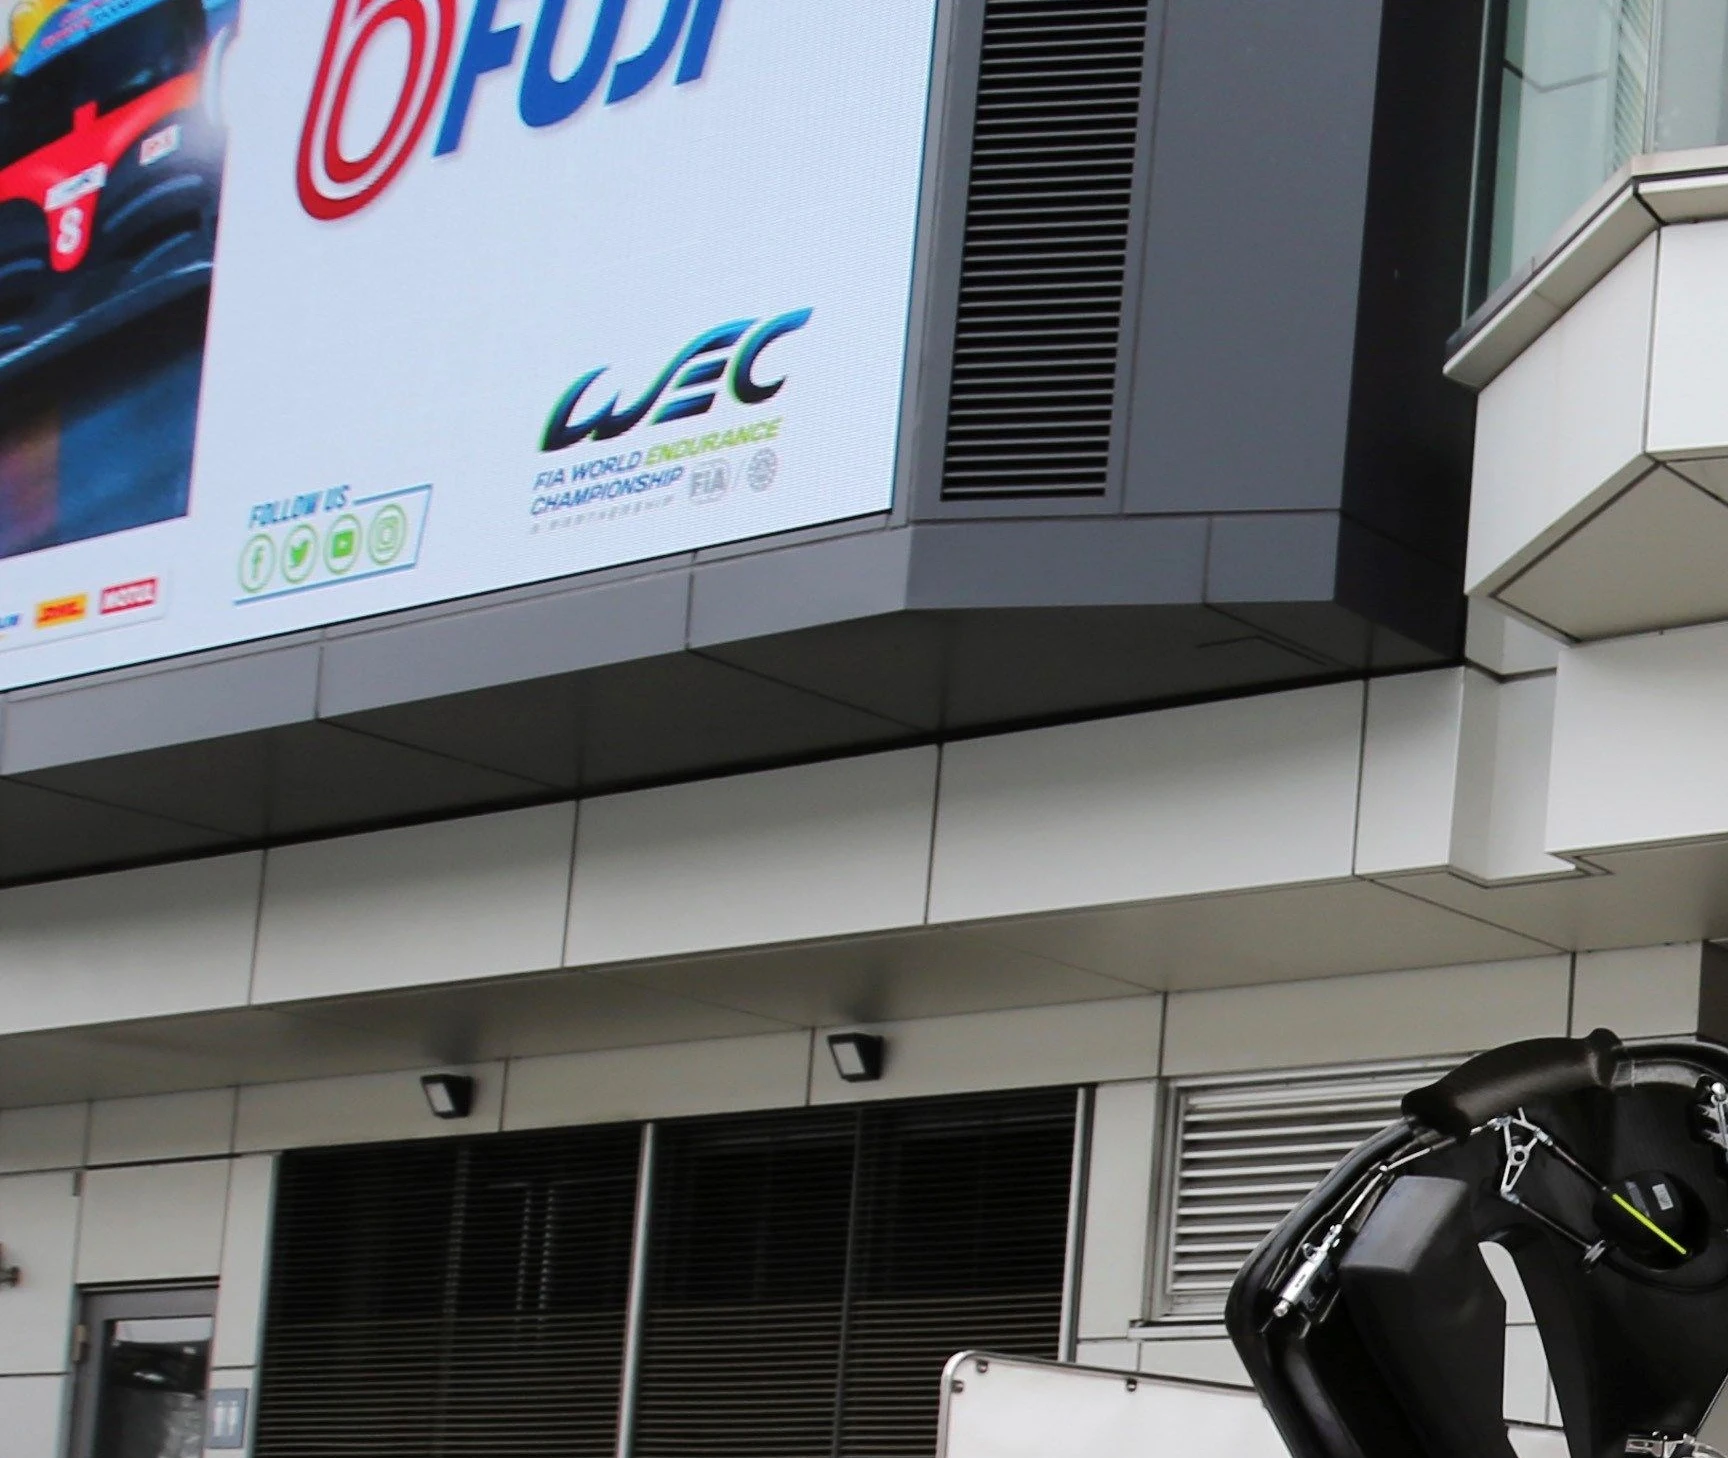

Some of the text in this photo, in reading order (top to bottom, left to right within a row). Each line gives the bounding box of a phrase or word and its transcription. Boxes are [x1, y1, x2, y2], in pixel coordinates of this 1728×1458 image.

[537, 306, 812, 453] WEC
[532, 416, 783, 492] FIA WORLD ENDURANCE
[249, 483, 351, 529] FOLLOW US
[529, 466, 684, 517] CHAMPIONSHIP
